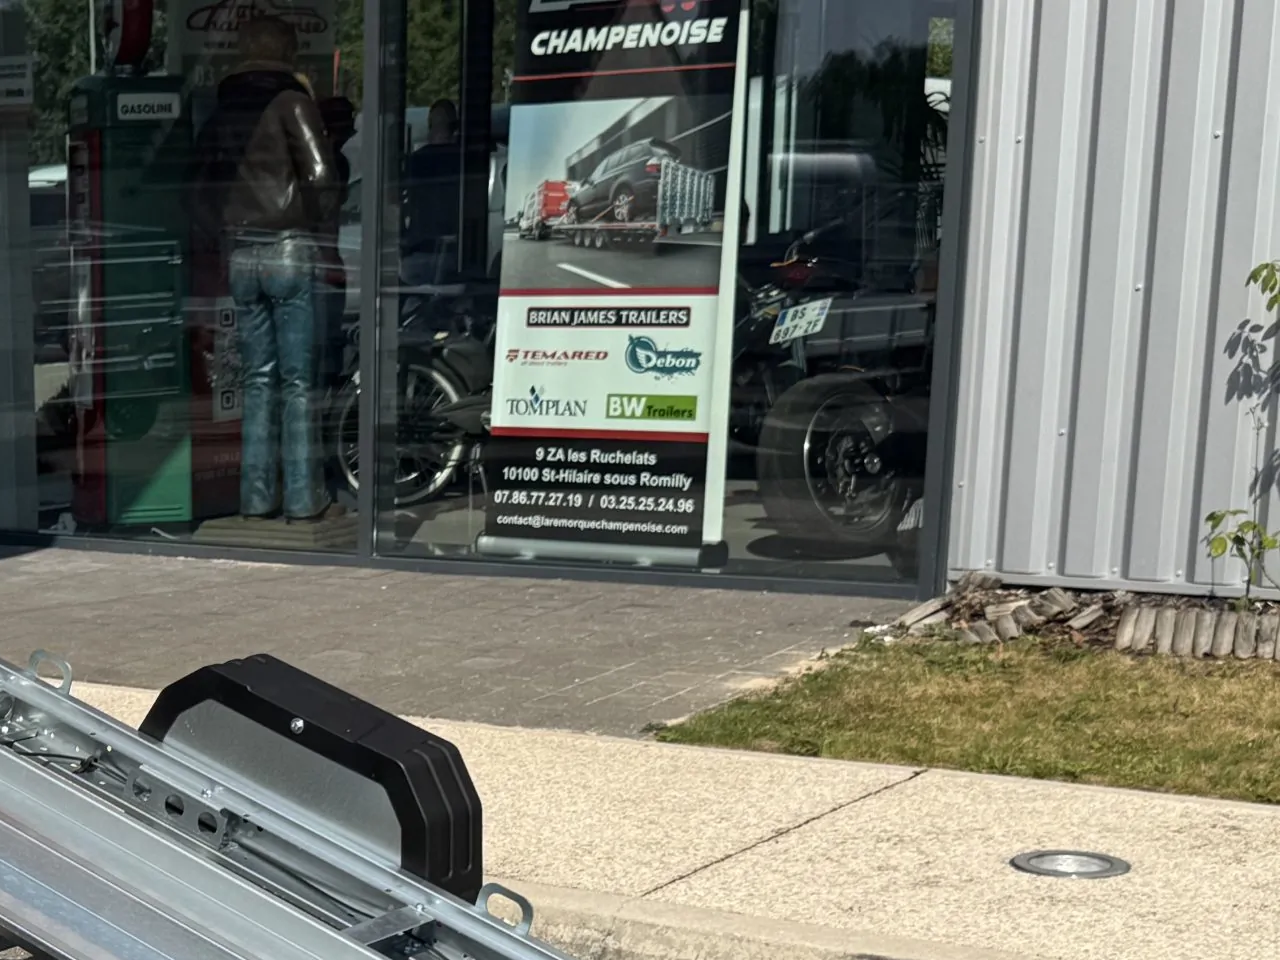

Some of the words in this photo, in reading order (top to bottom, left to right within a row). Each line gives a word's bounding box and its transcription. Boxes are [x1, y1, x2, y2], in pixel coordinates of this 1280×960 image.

[531, 17, 728, 56] CHAMPENOISE
[120, 103, 173, 115] GASOLINE
[528, 310, 570, 325] BRIAN
[571, 310, 616, 326] JAMES
[619, 310, 688, 325] TRAILERS
[521, 350, 608, 361] TEMARED
[638, 349, 697, 369] Debon
[506, 399, 588, 417] TOMPLAN
[609, 396, 647, 418] BW
[646, 404, 693, 419] Trailers
[536, 447, 545, 461] 9
[546, 448, 565, 462] ZA
[567, 449, 587, 463] les
[502, 467, 538, 481] 10100
[541, 468, 600, 484] St-Hilaire
[604, 474, 637, 486] sous
[639, 472, 693, 491] Romilly
[494, 490, 583, 508] 07.86.77.27.19
[588, 495, 594, 508] /
[600, 496, 695, 513] 03.25.25.24.96
[496, 514, 689, 535] contact@laremorquechampenoise.com
